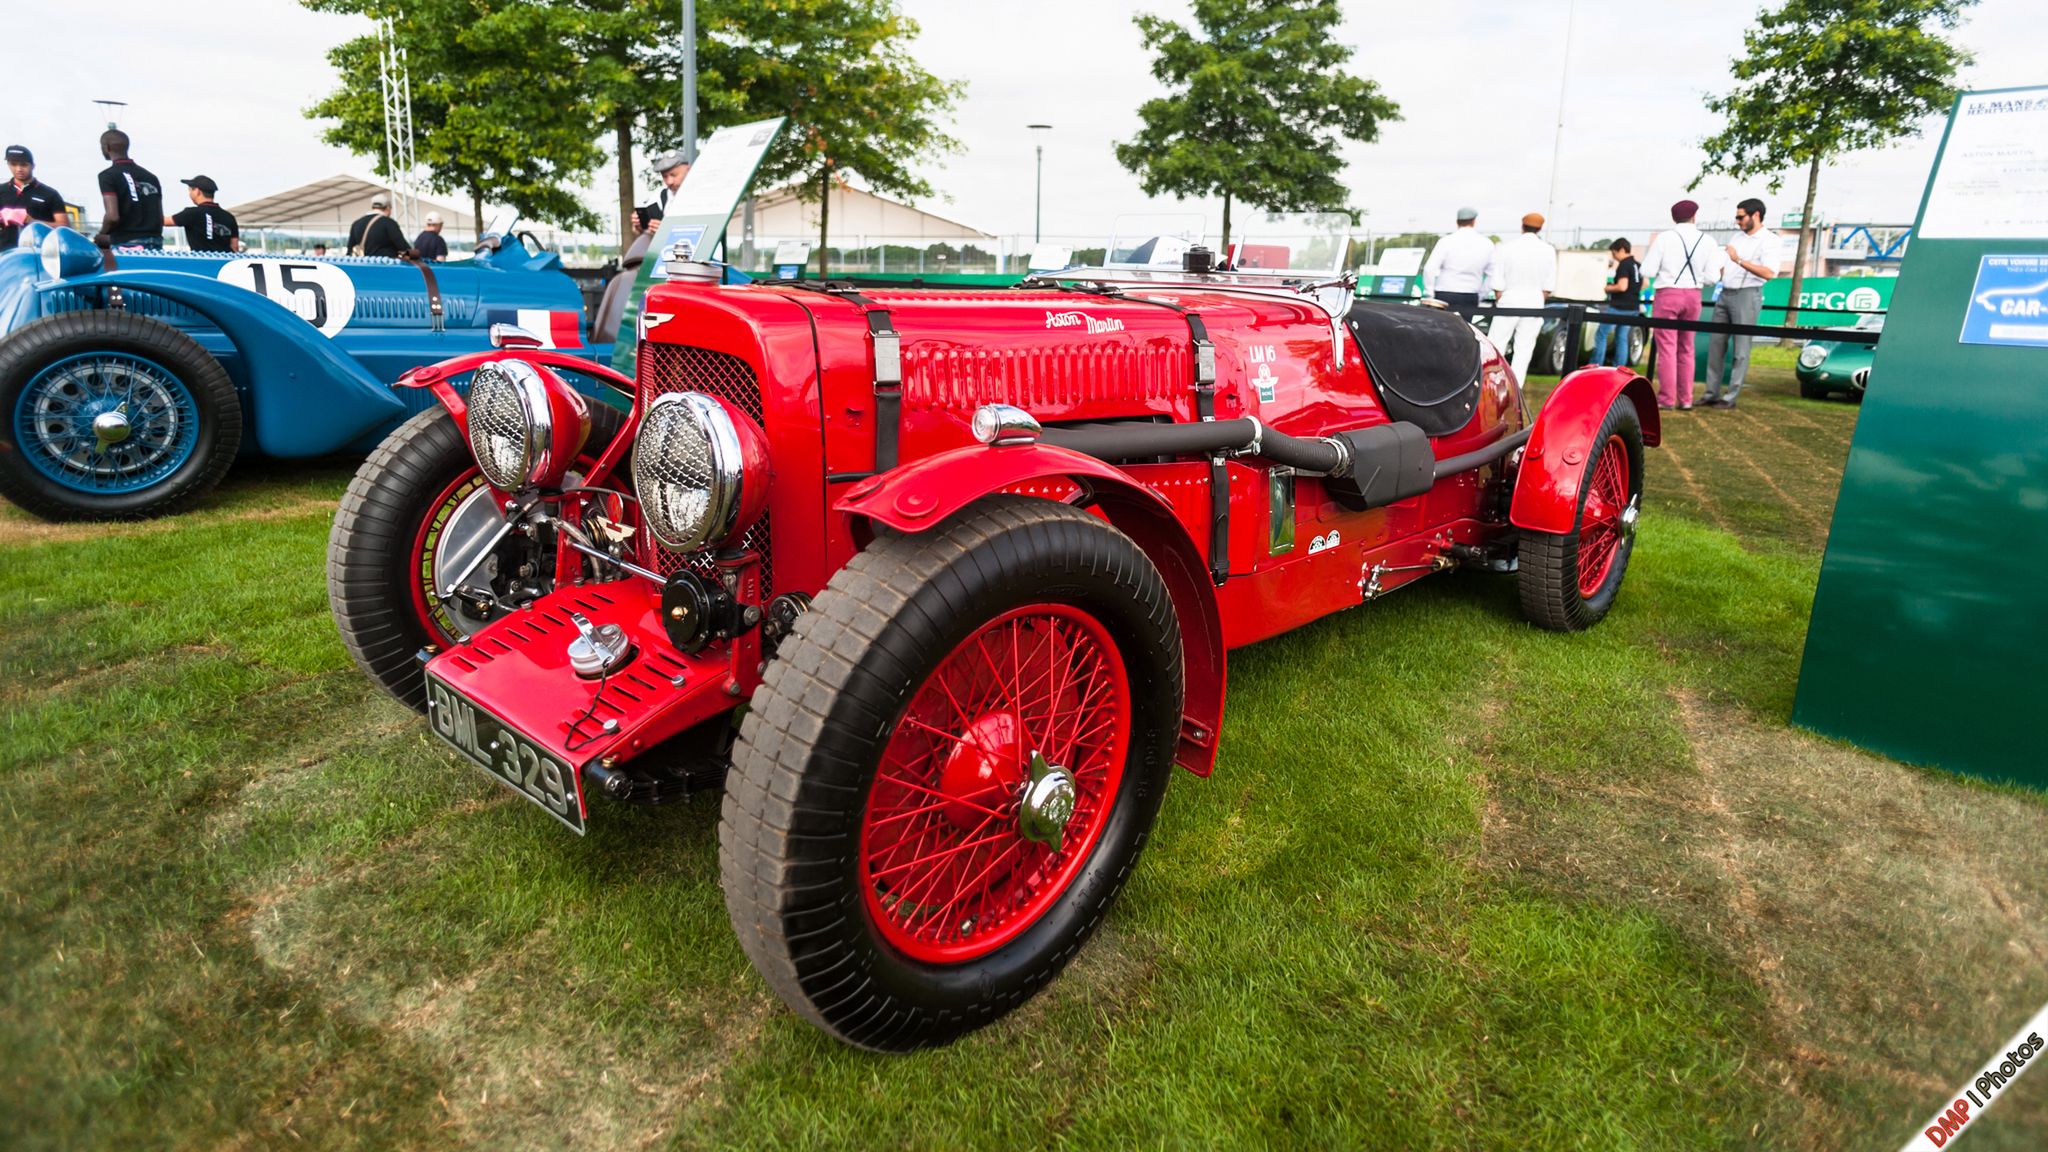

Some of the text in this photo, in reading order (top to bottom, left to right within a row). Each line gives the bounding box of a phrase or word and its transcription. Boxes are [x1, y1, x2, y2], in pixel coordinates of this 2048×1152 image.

[247, 263, 328, 329] 15
[1797, 292, 1846, 312] EFG
[1045, 311, 1125, 335] Aston Martin
[1249, 345, 1277, 363] LM 16
[434, 684, 568, 815] BML 329
